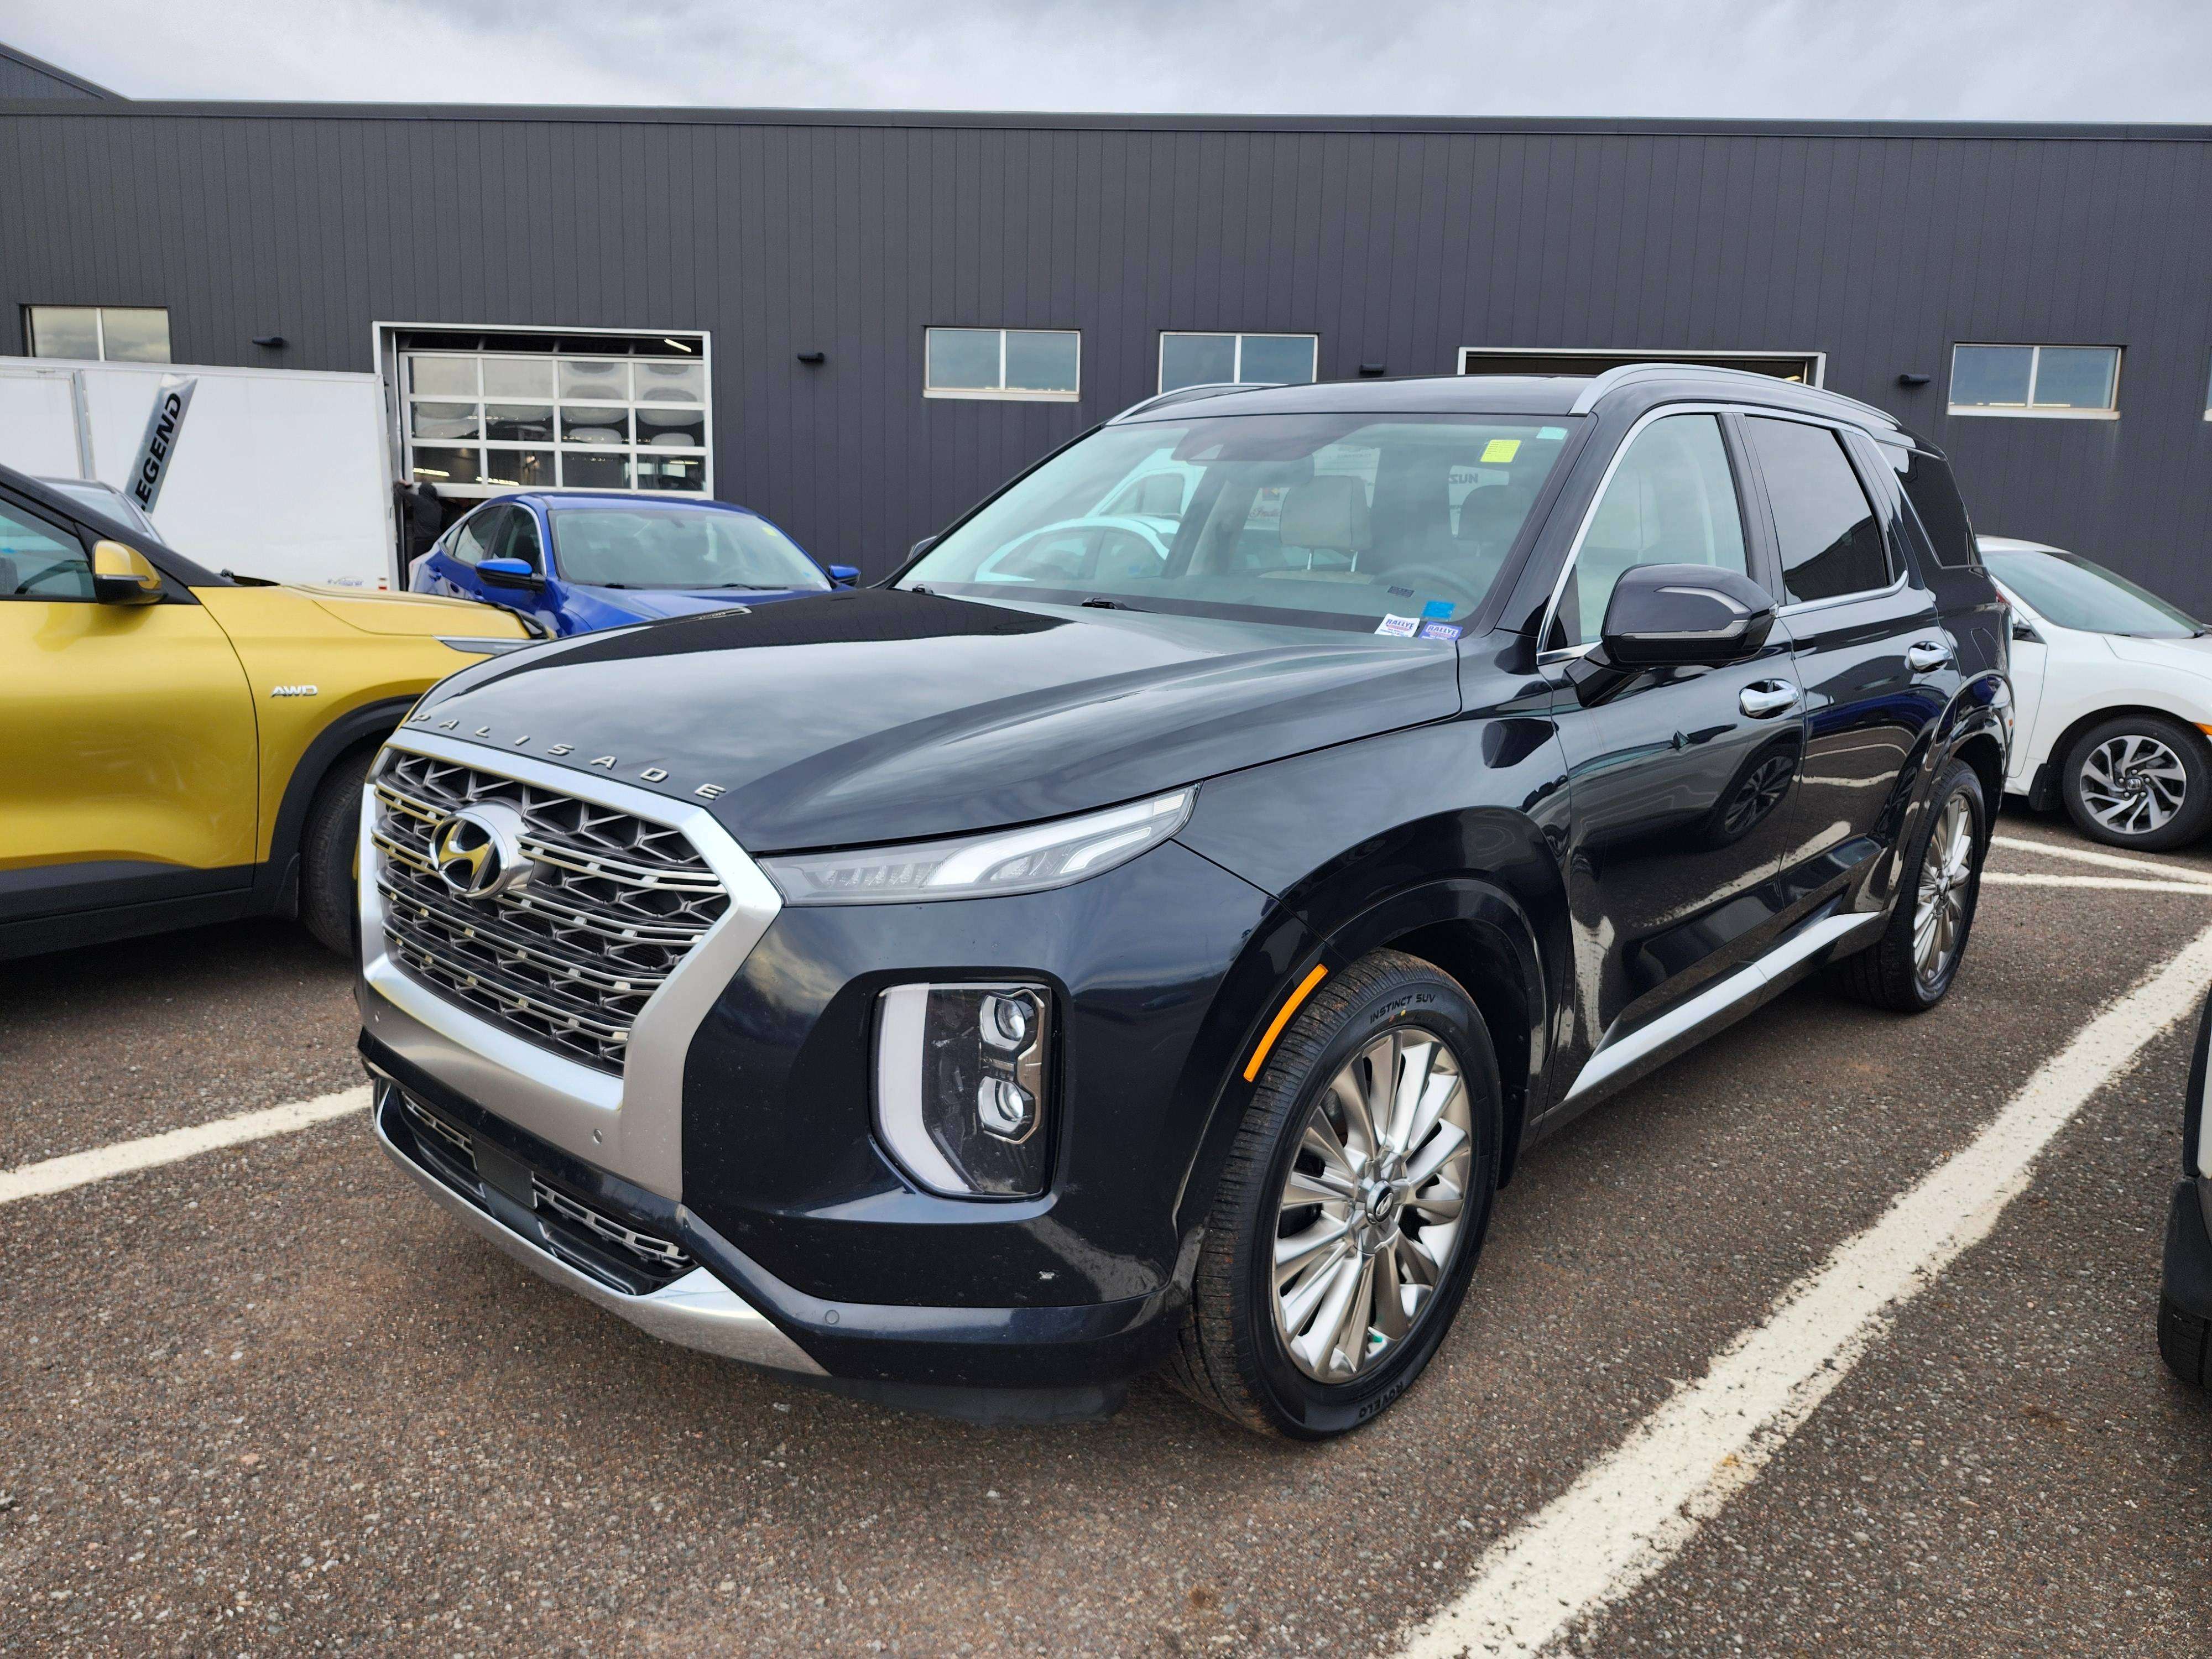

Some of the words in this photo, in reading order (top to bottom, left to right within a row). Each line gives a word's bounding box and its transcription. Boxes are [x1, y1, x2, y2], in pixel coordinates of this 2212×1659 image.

[135, 393, 181, 512] EGEND
[1386, 619, 1414, 629] RALLYE
[1428, 625, 1457, 637] RALLYE
[271, 685, 318, 697] AWD
[410, 714, 727, 800] PALISADE
[1370, 995, 1413, 1024] INSTINCT
[1416, 993, 1436, 1003] SUV
